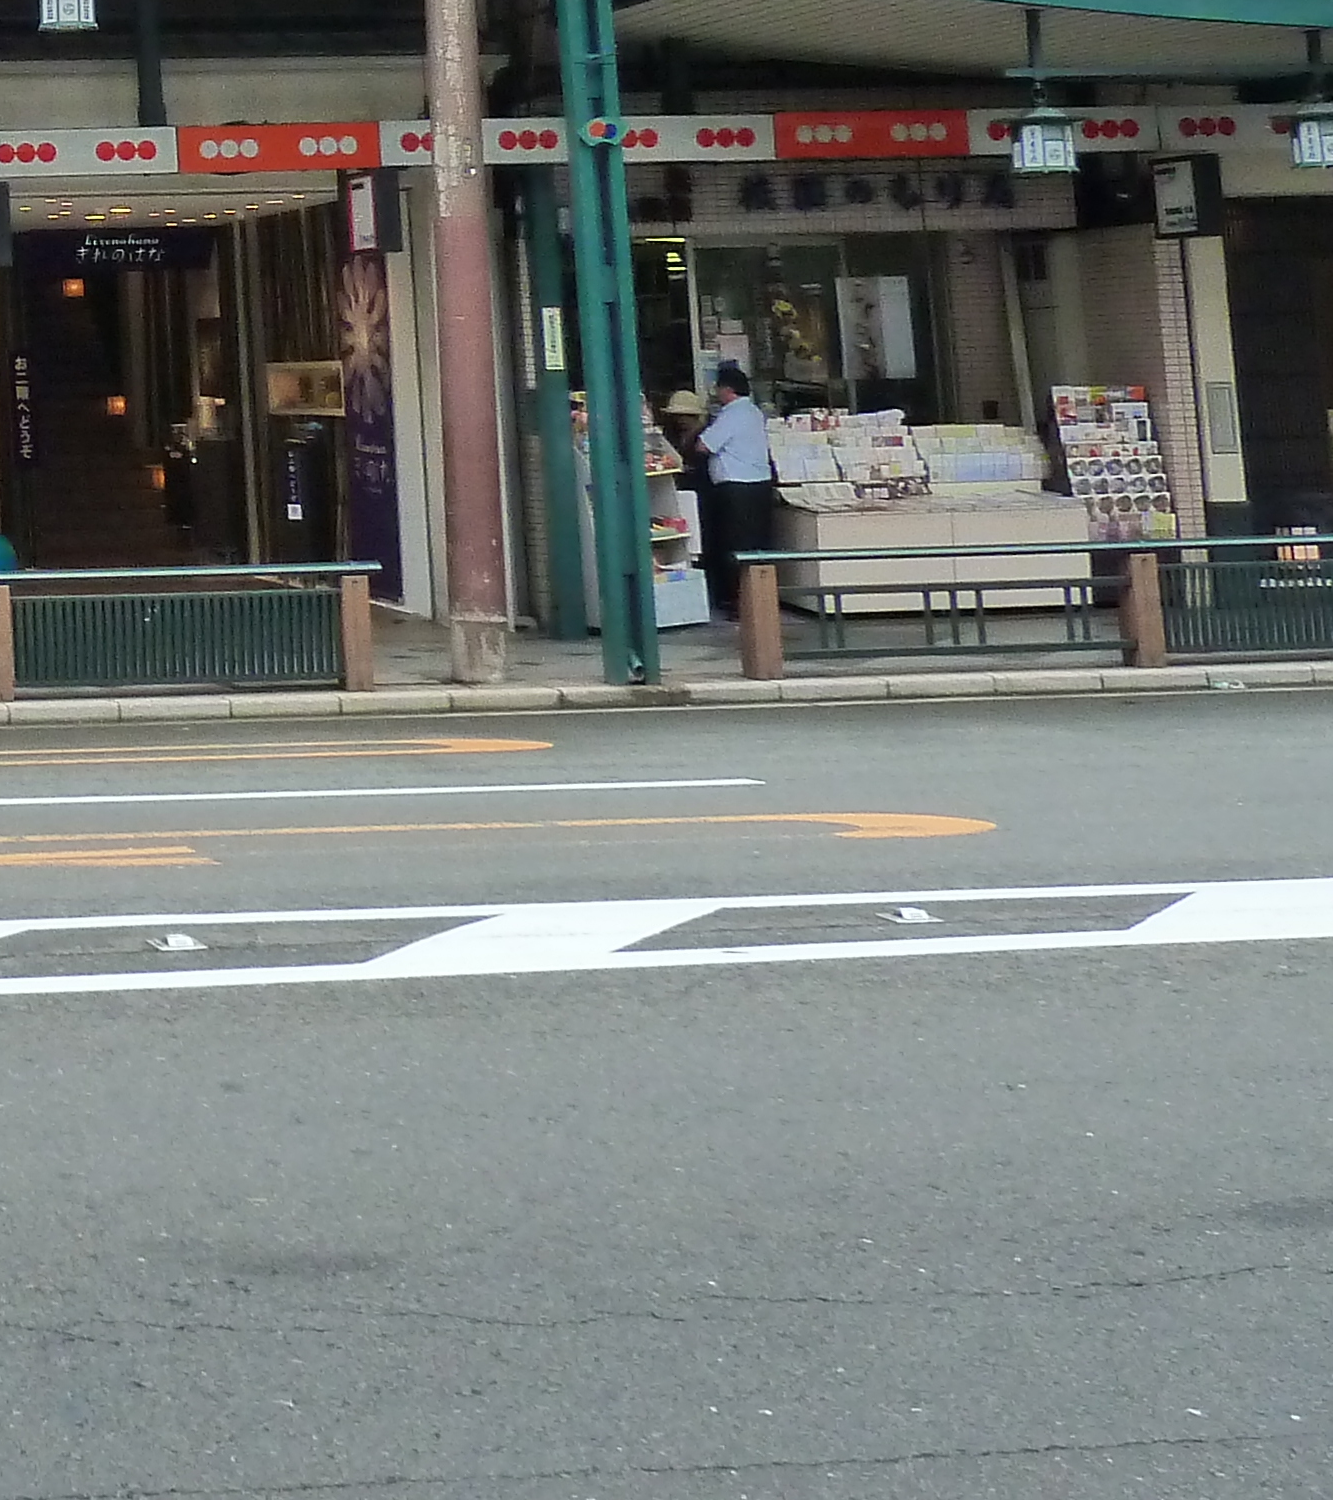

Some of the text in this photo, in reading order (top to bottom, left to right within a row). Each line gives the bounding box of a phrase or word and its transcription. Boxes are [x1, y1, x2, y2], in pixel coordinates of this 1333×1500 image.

[76, 246, 166, 264] きれのはな
